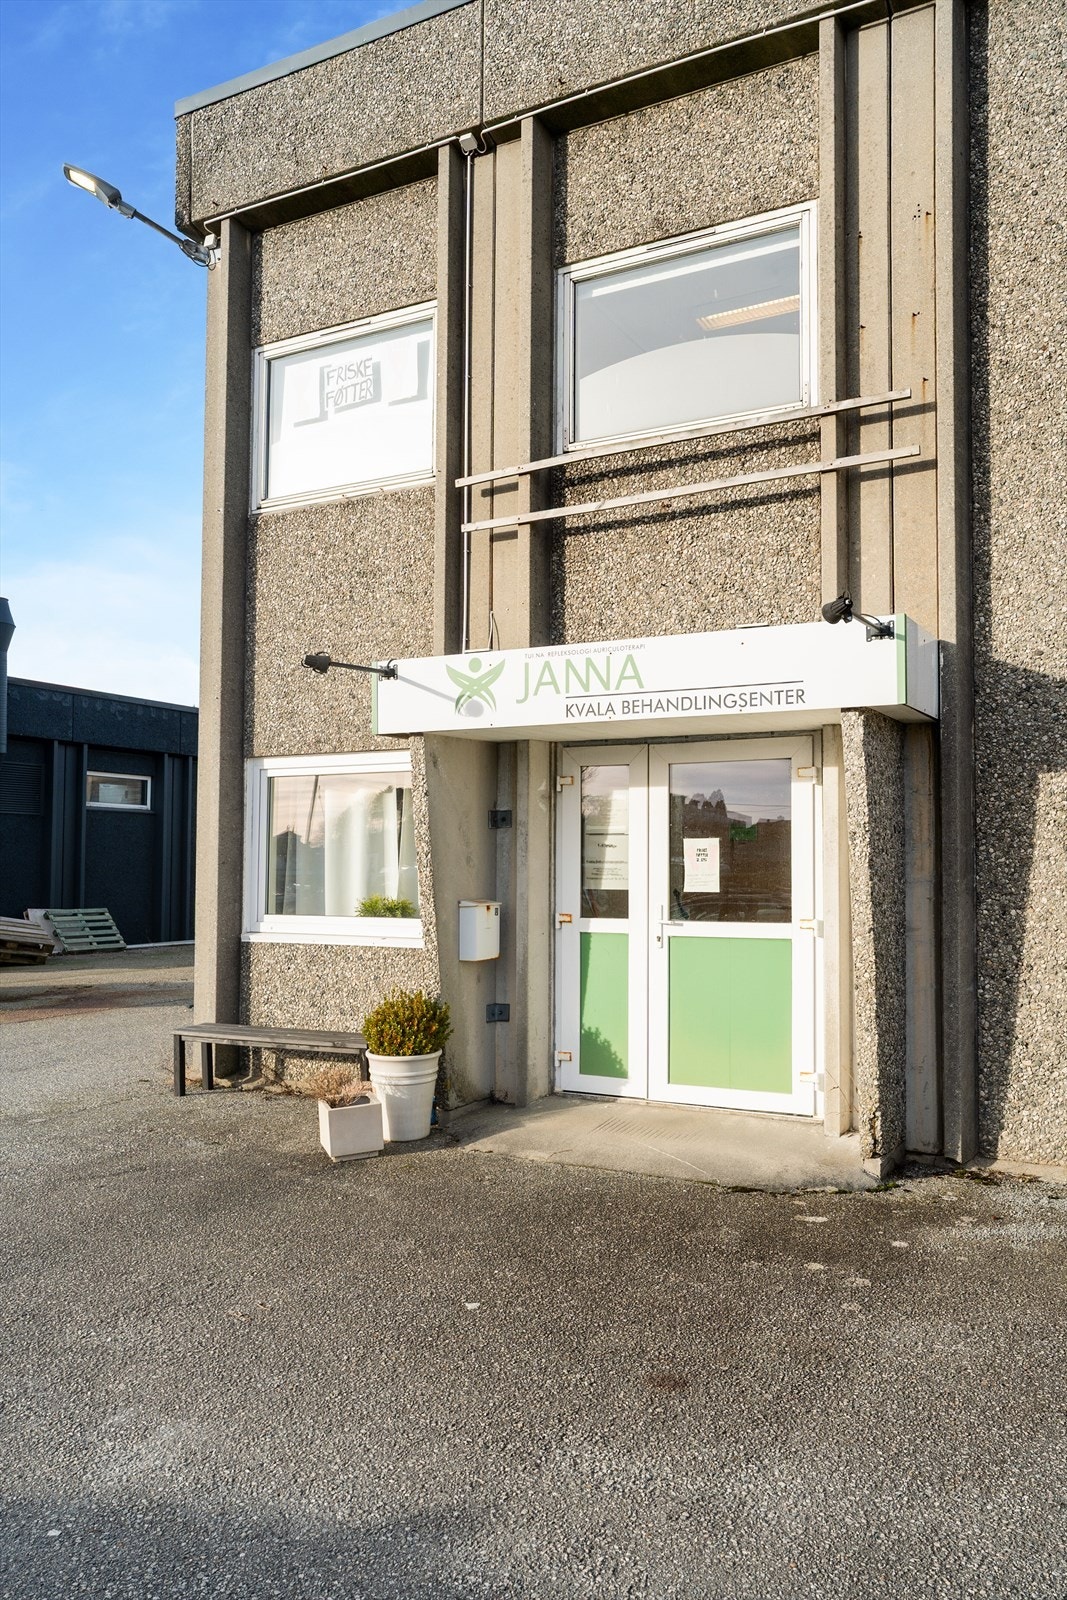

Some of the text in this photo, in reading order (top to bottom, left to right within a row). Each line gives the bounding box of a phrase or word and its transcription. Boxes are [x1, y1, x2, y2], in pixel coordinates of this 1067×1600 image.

[326, 357, 374, 386] FRISKE
[325, 378, 374, 408] FØTTER
[547, 648, 592, 658] REFLEKSOLOGI
[593, 644, 646, 654] AURICULOTERAPI
[516, 654, 645, 704] JANNA
[565, 688, 806, 718] KVALA BEHANDLINGSENTER
